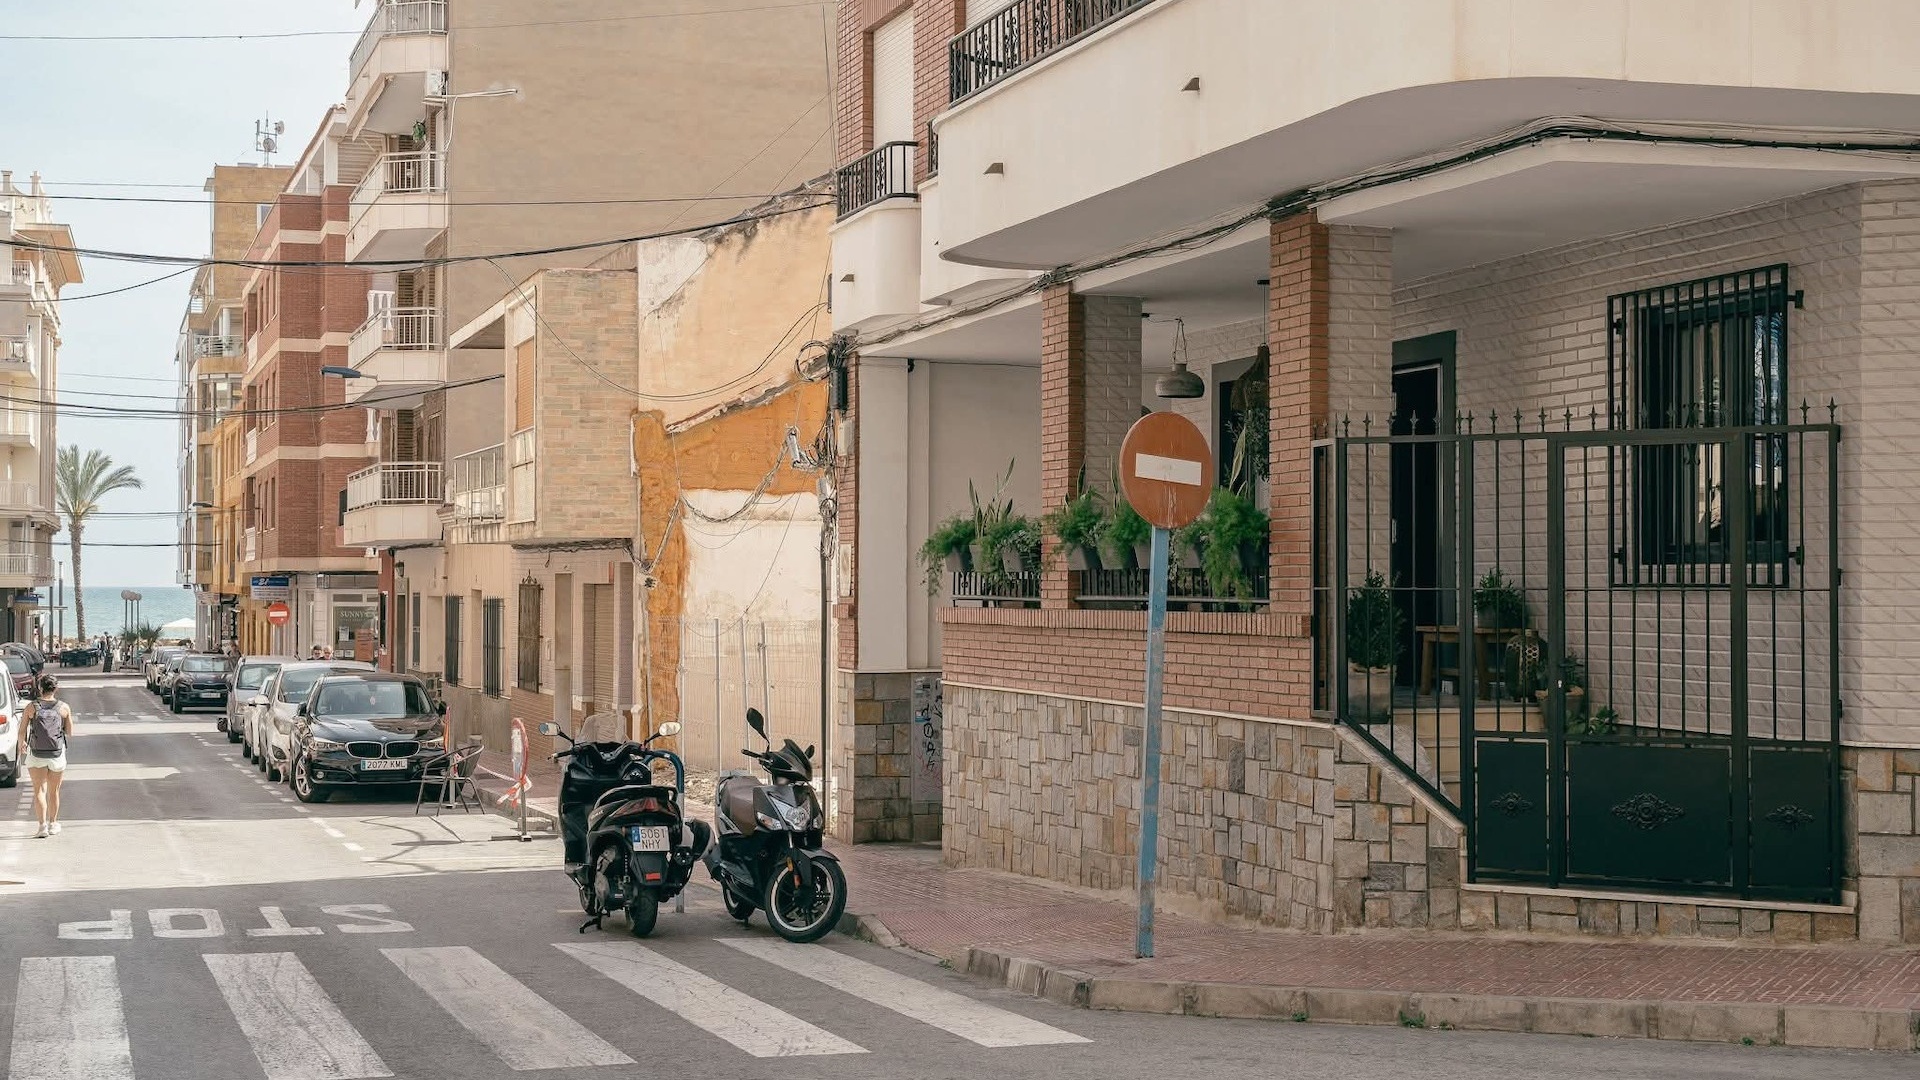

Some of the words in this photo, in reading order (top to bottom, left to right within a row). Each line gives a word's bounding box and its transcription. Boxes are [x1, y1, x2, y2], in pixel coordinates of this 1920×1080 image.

[340, 610, 364, 618] SUNNY
[367, 761, 388, 769] 2077
[390, 760, 406, 768] KML
[641, 828, 666, 839] 5061
[642, 839, 661, 849] NHY
[57, 903, 416, 940] STOP
